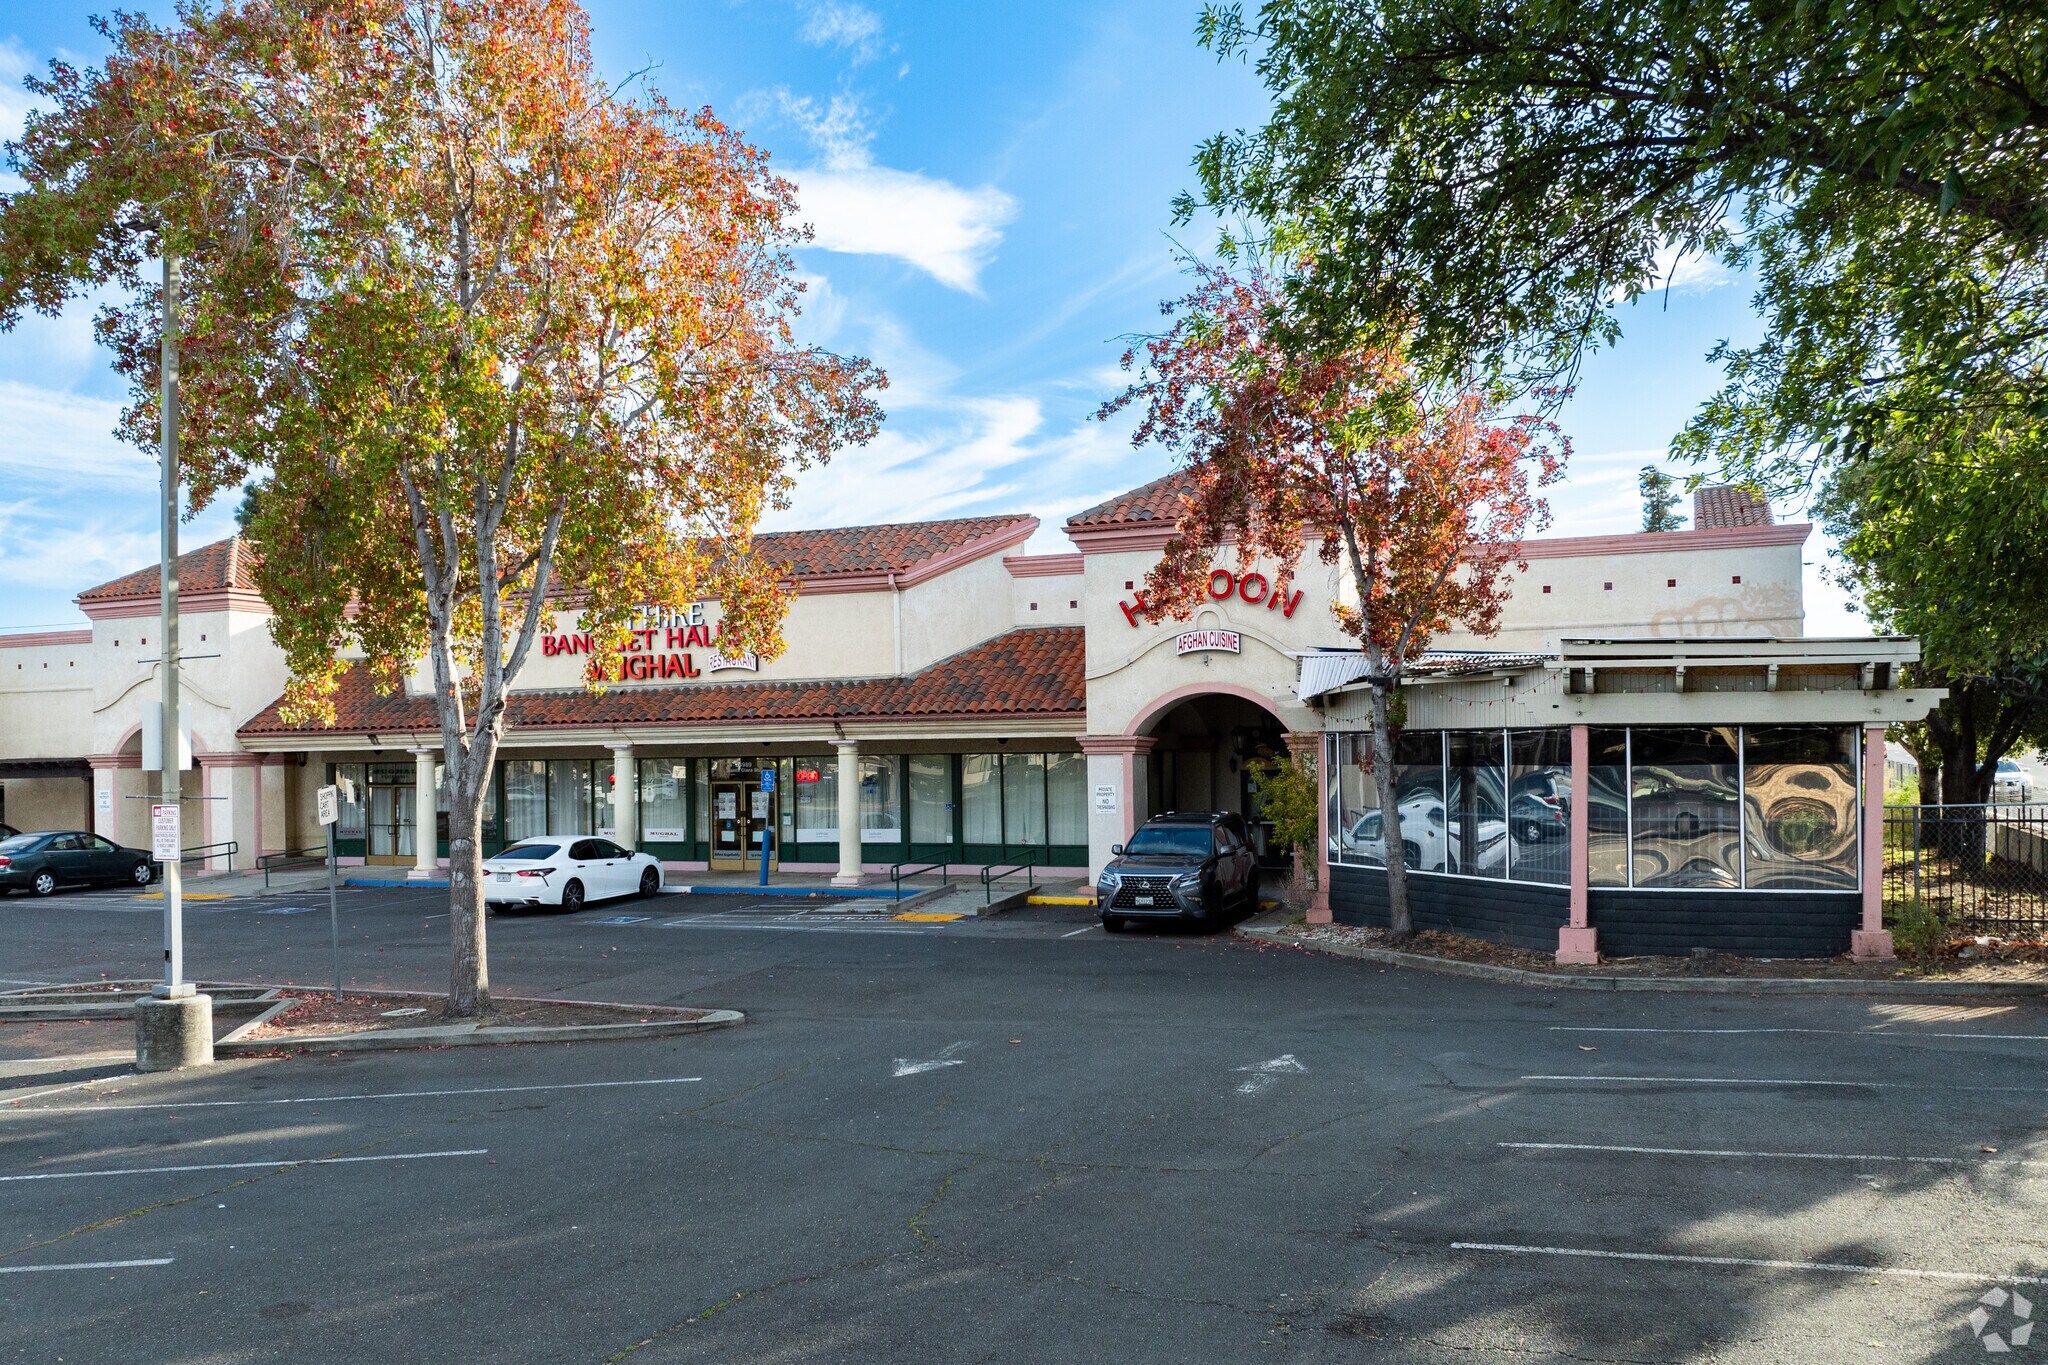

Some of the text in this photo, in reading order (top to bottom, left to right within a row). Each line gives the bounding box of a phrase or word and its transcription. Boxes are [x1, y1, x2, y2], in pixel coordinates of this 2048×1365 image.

[1119, 569, 1304, 628] HOON
[542, 630, 658, 656] BANET
[1178, 631, 1238, 653] AFGHAN CUISINE
[590, 653, 700, 681] GHAL
[796, 771, 819, 781] OPEN
